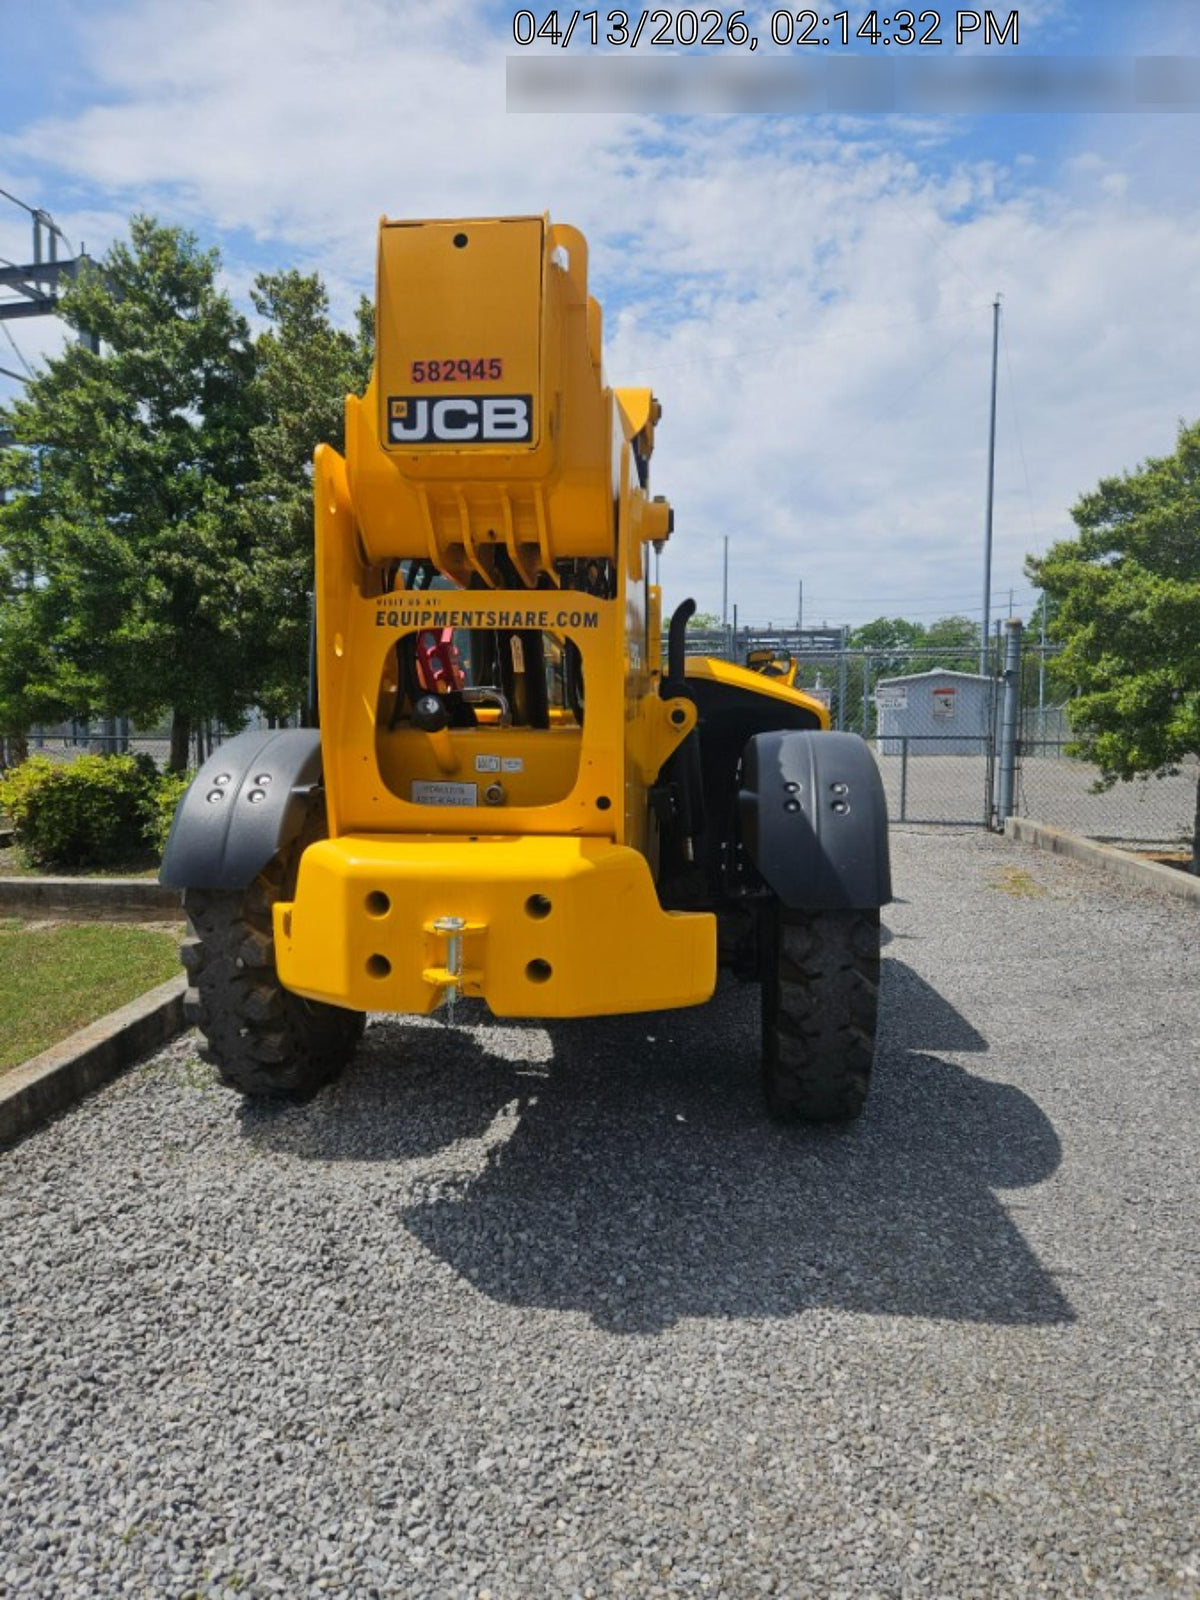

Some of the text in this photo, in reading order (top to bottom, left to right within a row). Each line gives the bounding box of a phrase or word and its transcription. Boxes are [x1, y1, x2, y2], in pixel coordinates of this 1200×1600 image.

[411, 358, 503, 383] 582945
[391, 399, 529, 441] JCB
[376, 610, 599, 629] EQUIPMENTSHARE.COM
